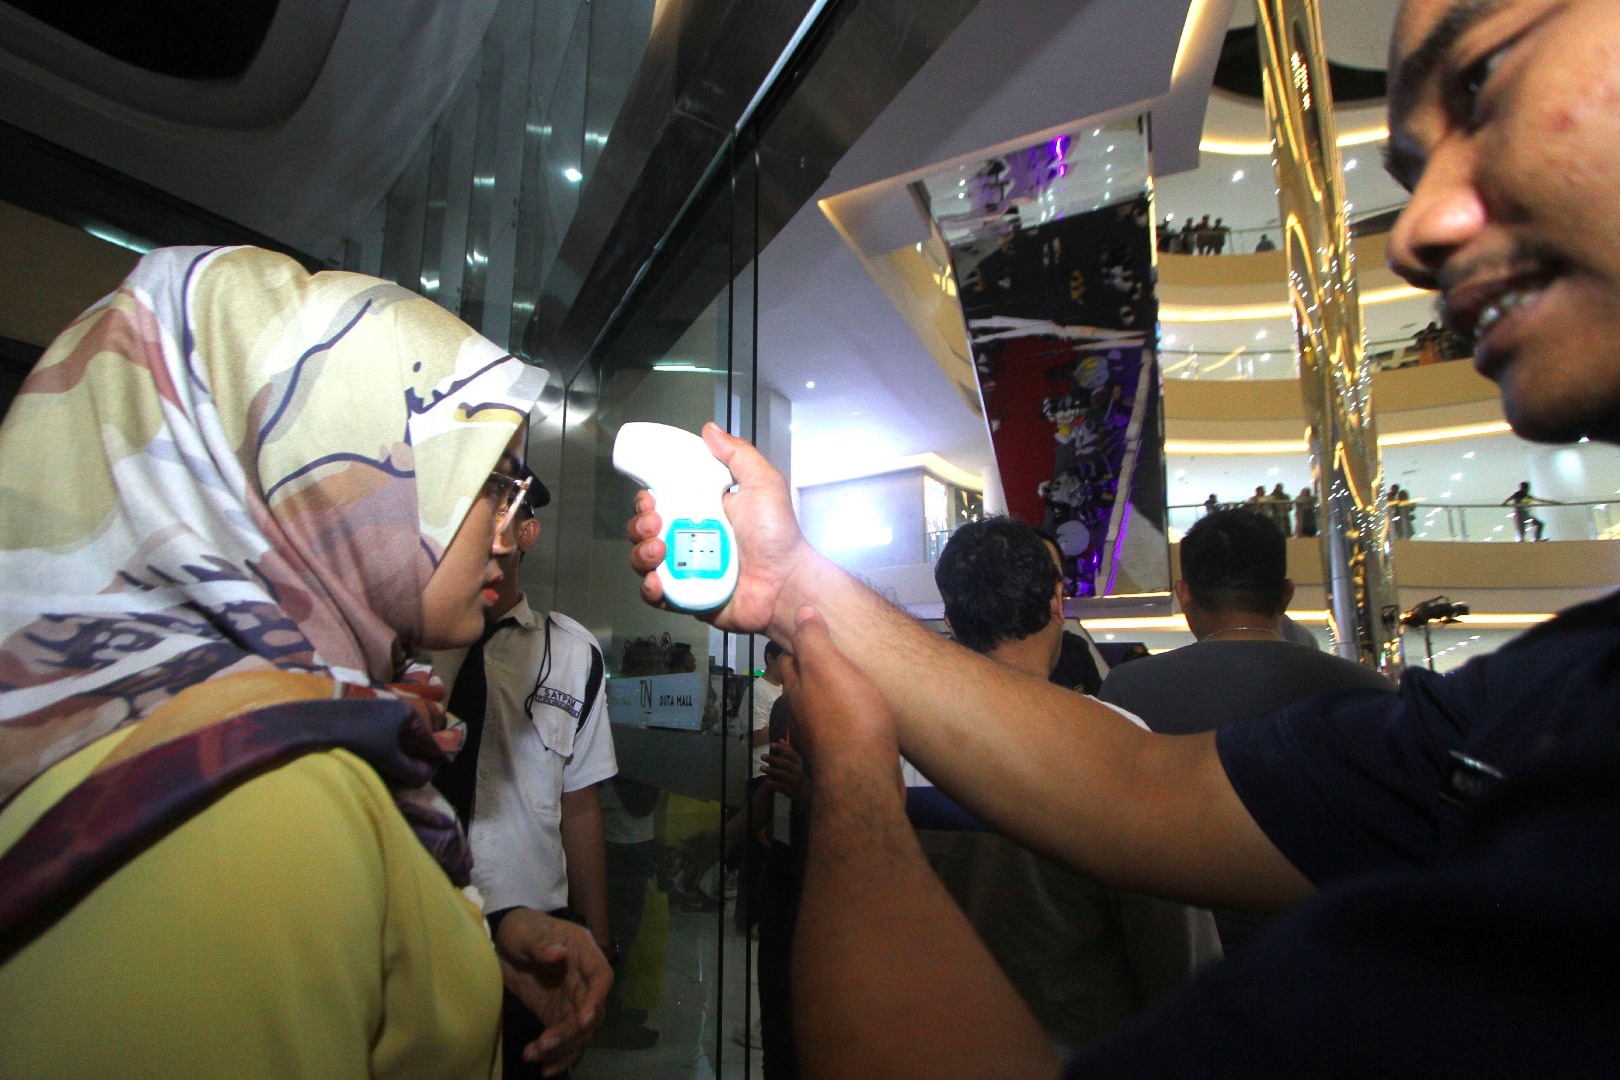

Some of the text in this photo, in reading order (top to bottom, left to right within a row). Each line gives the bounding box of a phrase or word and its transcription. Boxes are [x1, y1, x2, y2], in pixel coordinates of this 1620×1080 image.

[544, 689, 576, 709] SATPAM
[659, 694, 693, 707] DUTA MALL
